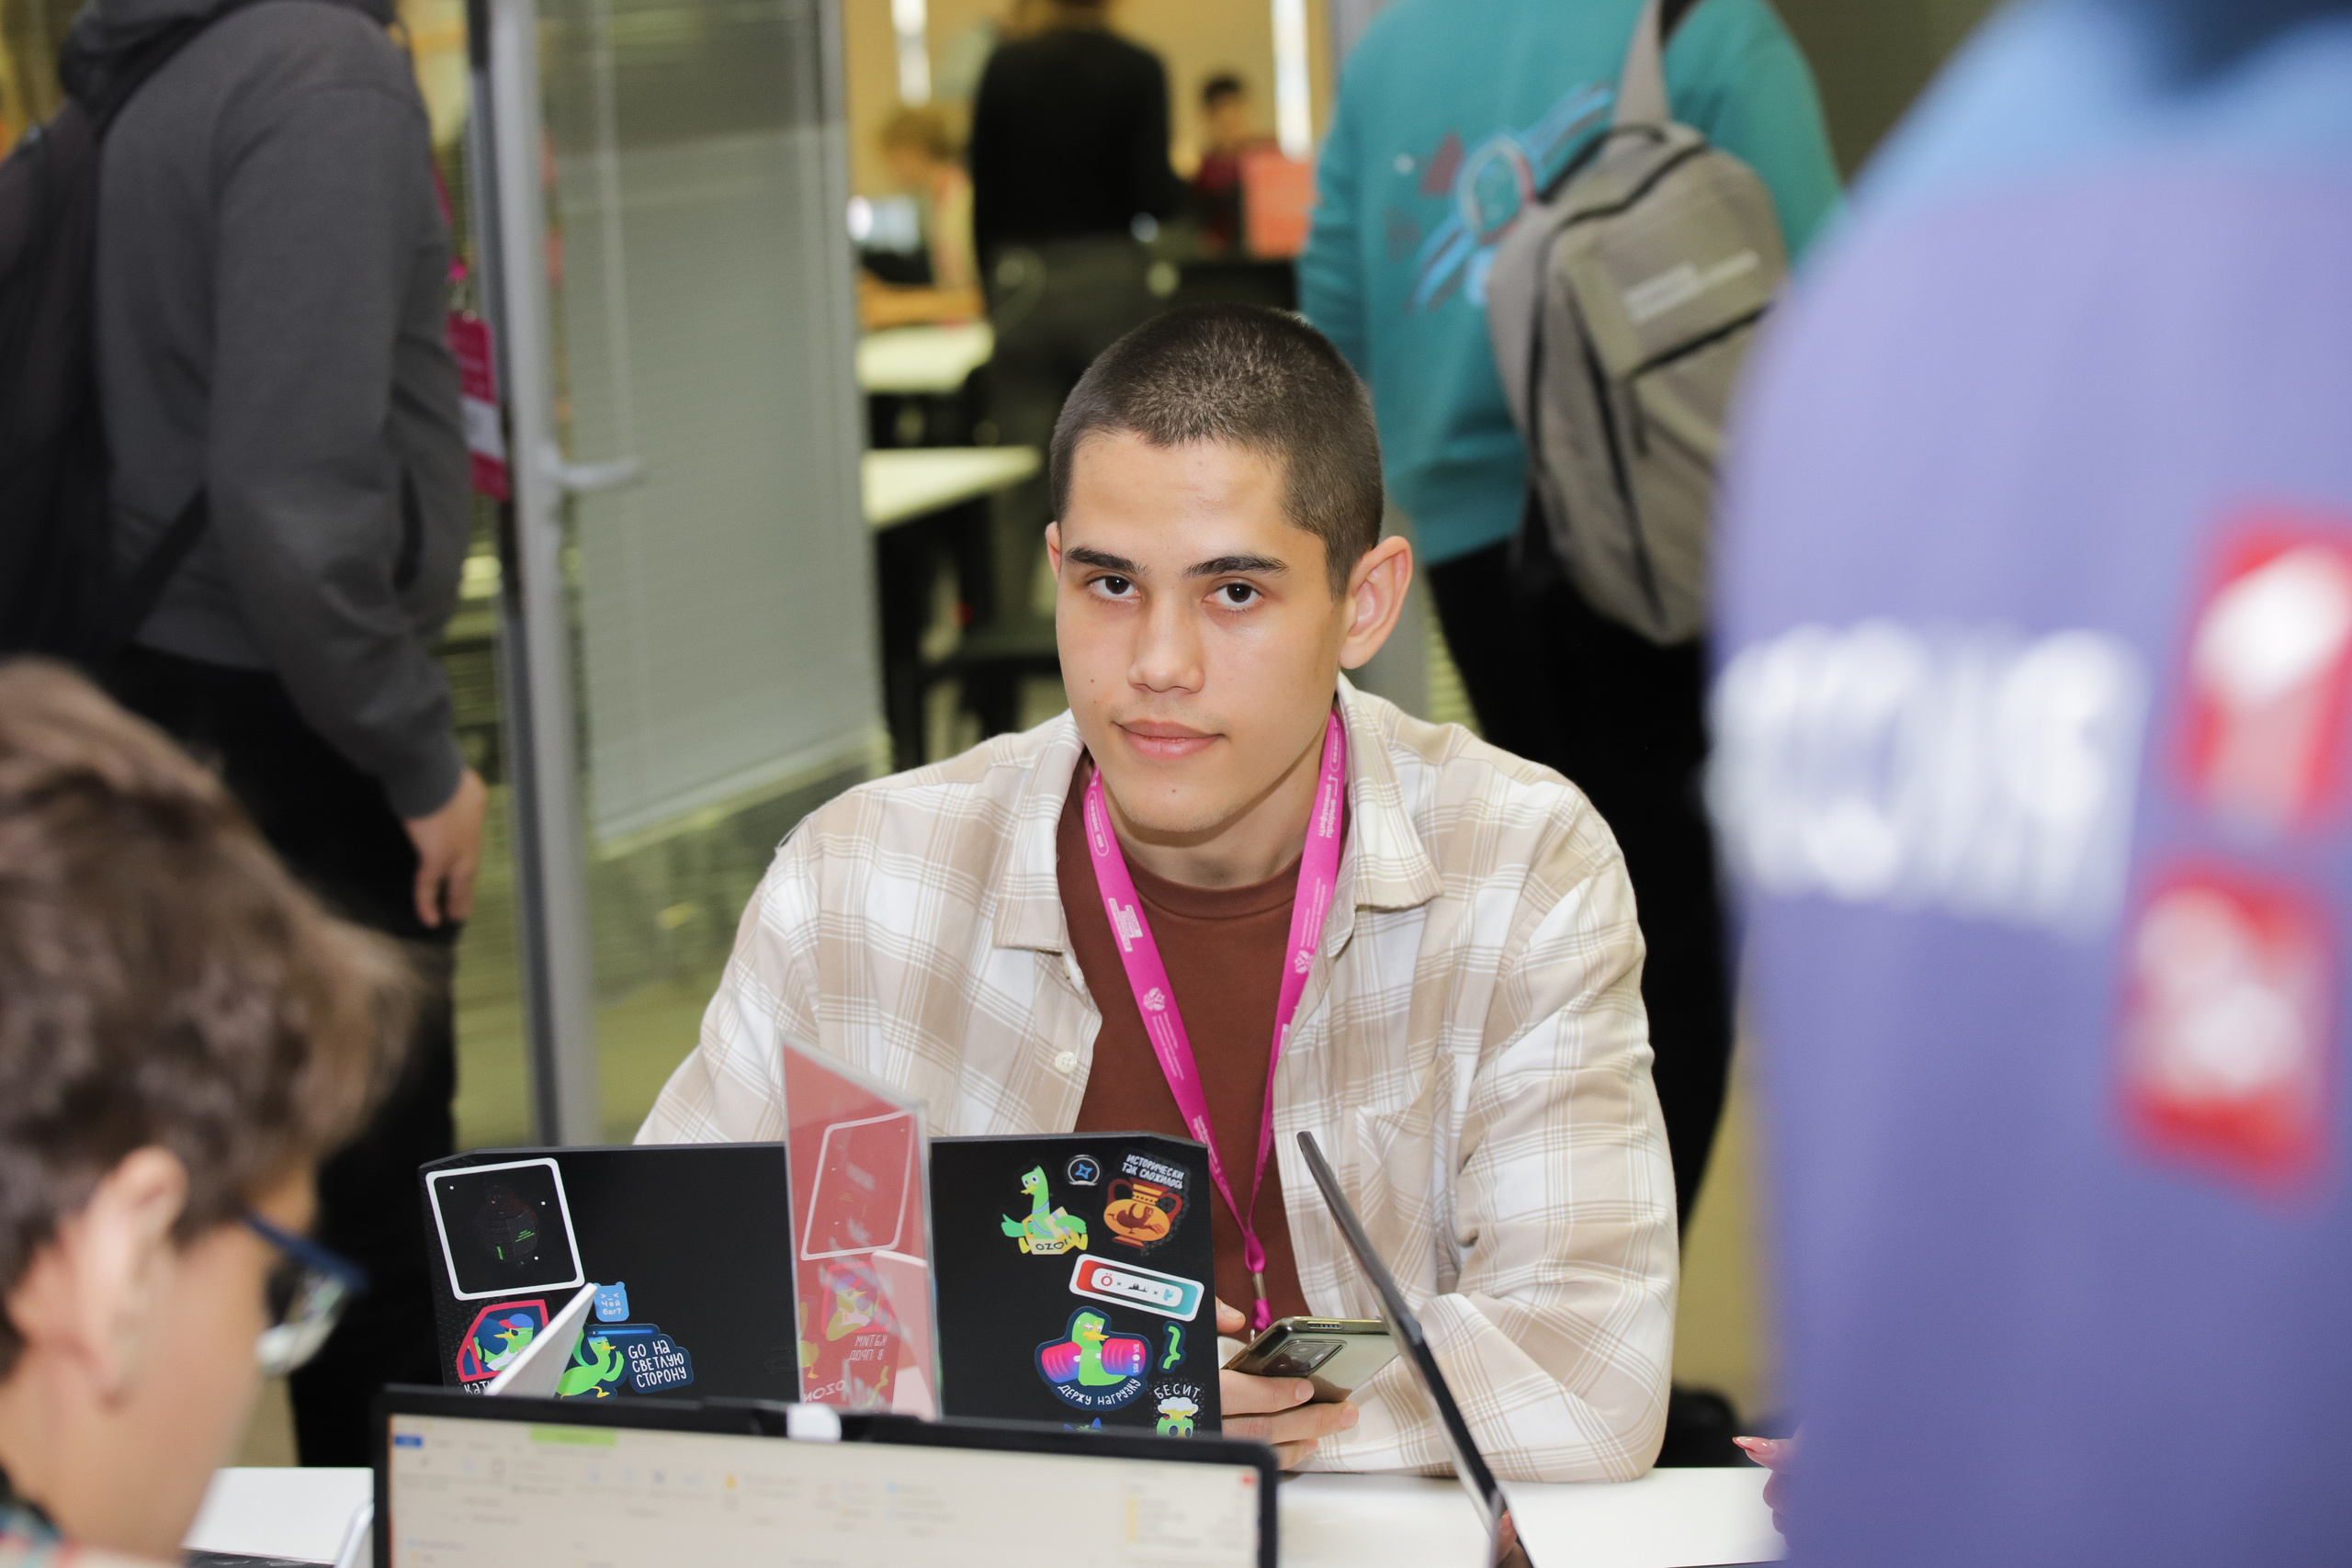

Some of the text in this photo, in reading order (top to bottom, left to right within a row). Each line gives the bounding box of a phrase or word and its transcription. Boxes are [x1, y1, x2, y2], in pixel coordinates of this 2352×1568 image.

[1317, 783, 1332, 836] цифровой
[1326, 798, 1337, 838] прорыв
[1125, 1154, 1185, 1180] ИСТОРИЧЕСКИ
[601, 1299, 621, 1307] Чей
[602, 1307, 622, 1315] баг?
[628, 1344, 647, 1359] GO
[632, 1352, 684, 1373] СВЕТЛУЮ
[636, 1366, 687, 1388] СТОРОНУ
[1057, 1384, 1092, 1405] ДЕРЖУ
